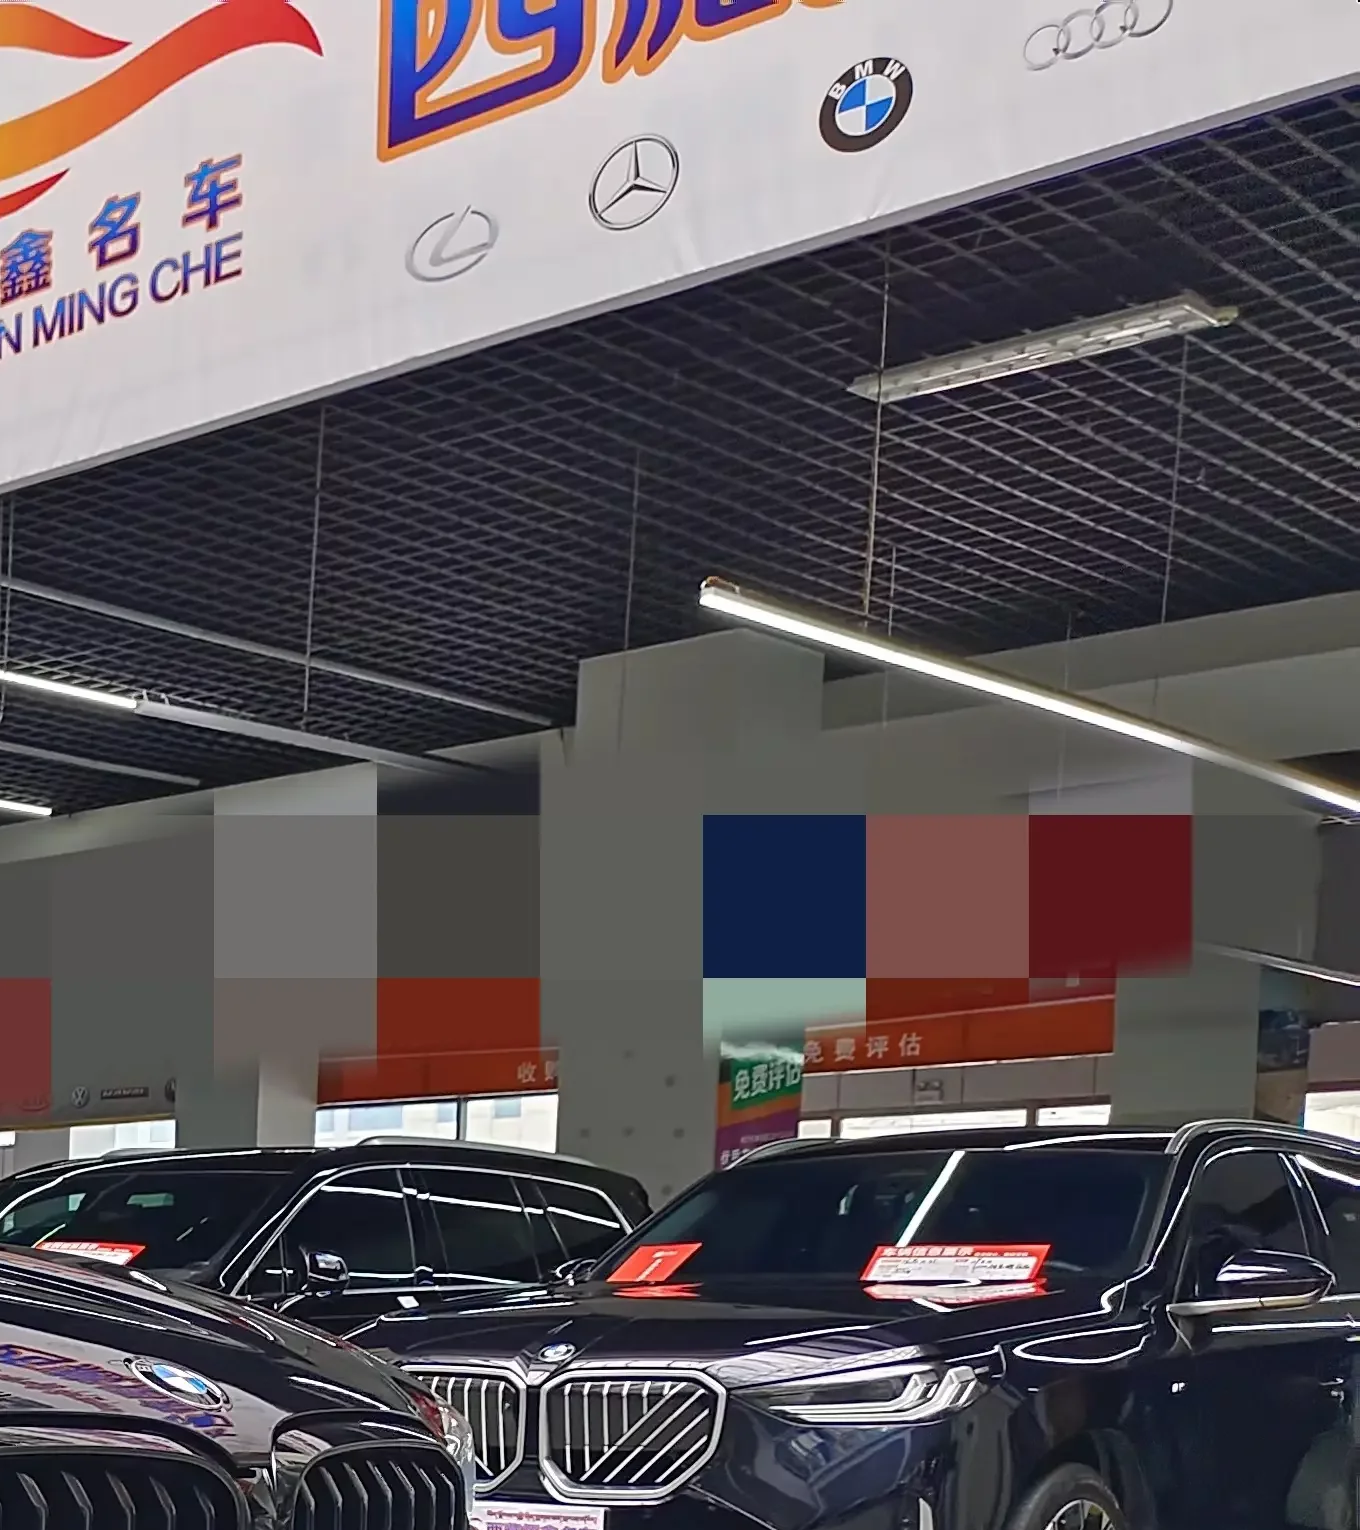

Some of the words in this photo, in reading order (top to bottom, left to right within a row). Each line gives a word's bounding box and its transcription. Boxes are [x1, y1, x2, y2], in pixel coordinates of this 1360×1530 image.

[829, 59, 906, 100] BMW
[32, 272, 139, 351] MING
[148, 233, 244, 302] CHE
[803, 1032, 924, 1063] 免费评估
